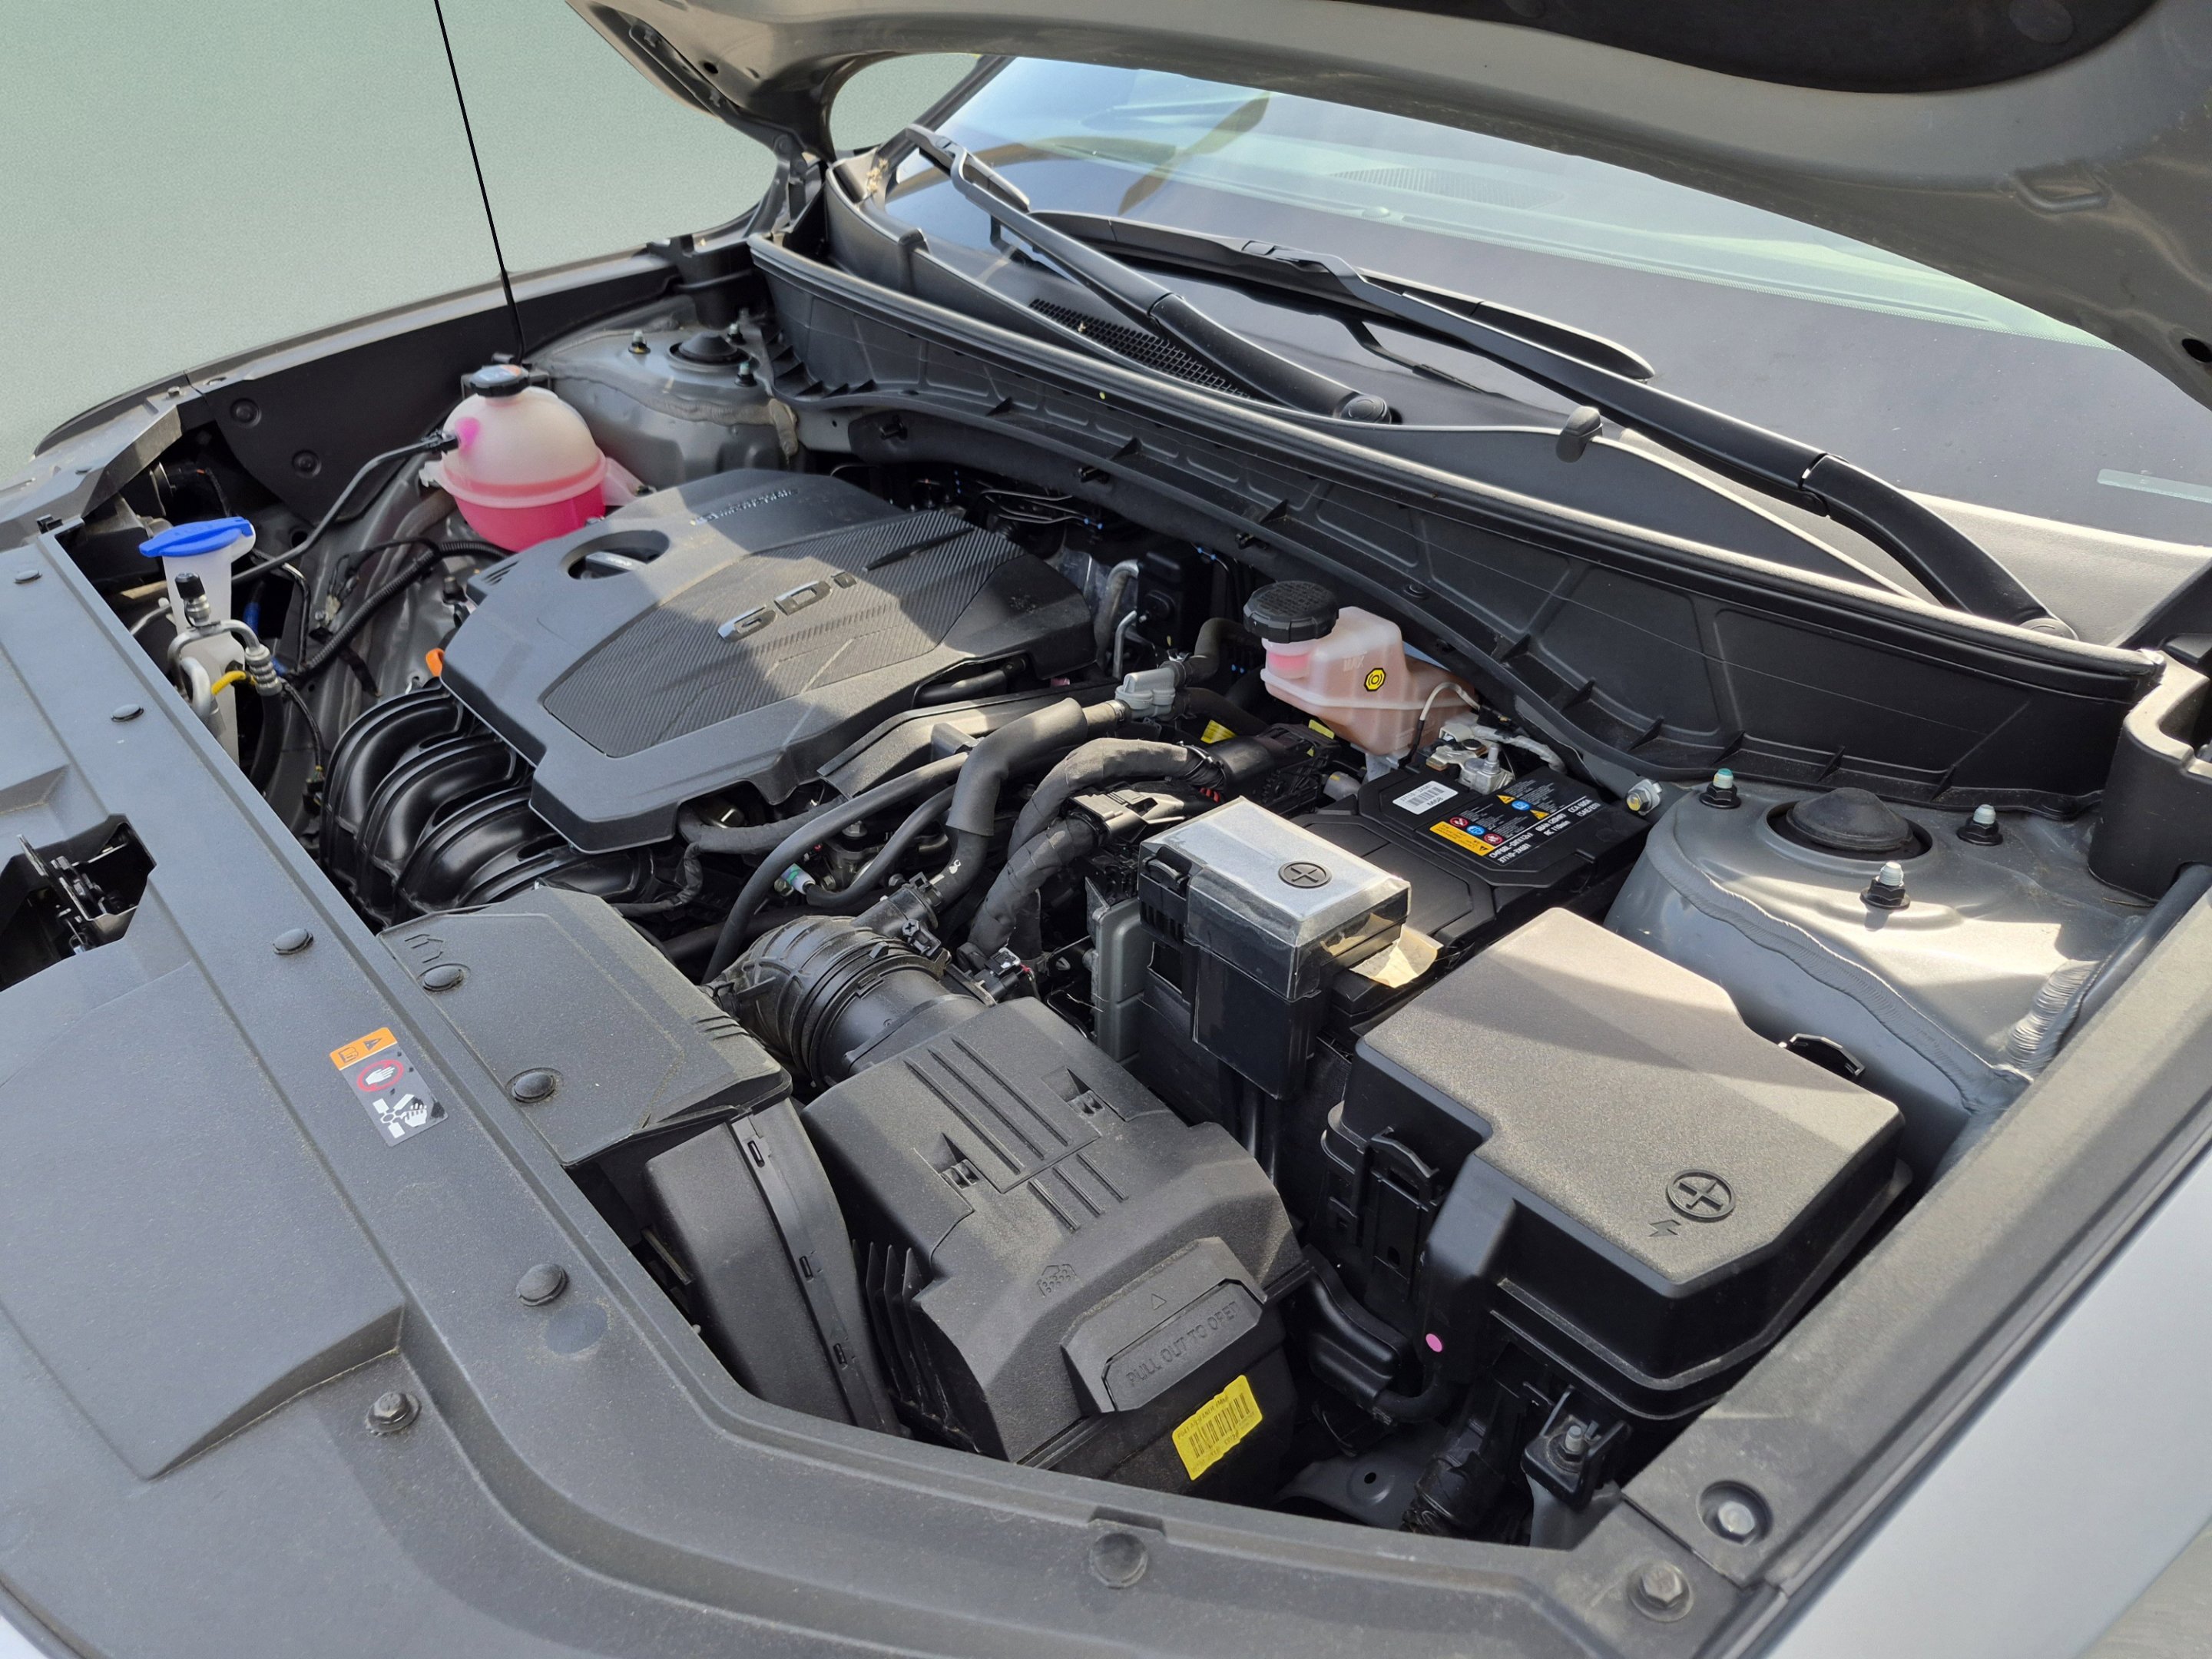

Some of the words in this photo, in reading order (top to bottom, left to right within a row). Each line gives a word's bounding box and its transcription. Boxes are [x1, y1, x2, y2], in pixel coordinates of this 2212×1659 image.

[1568, 805, 1581, 813] CCA
[1126, 1358, 1162, 1387] PULL
[1160, 1336, 1187, 1363] OUT
[1187, 1324, 1207, 1339] TO
